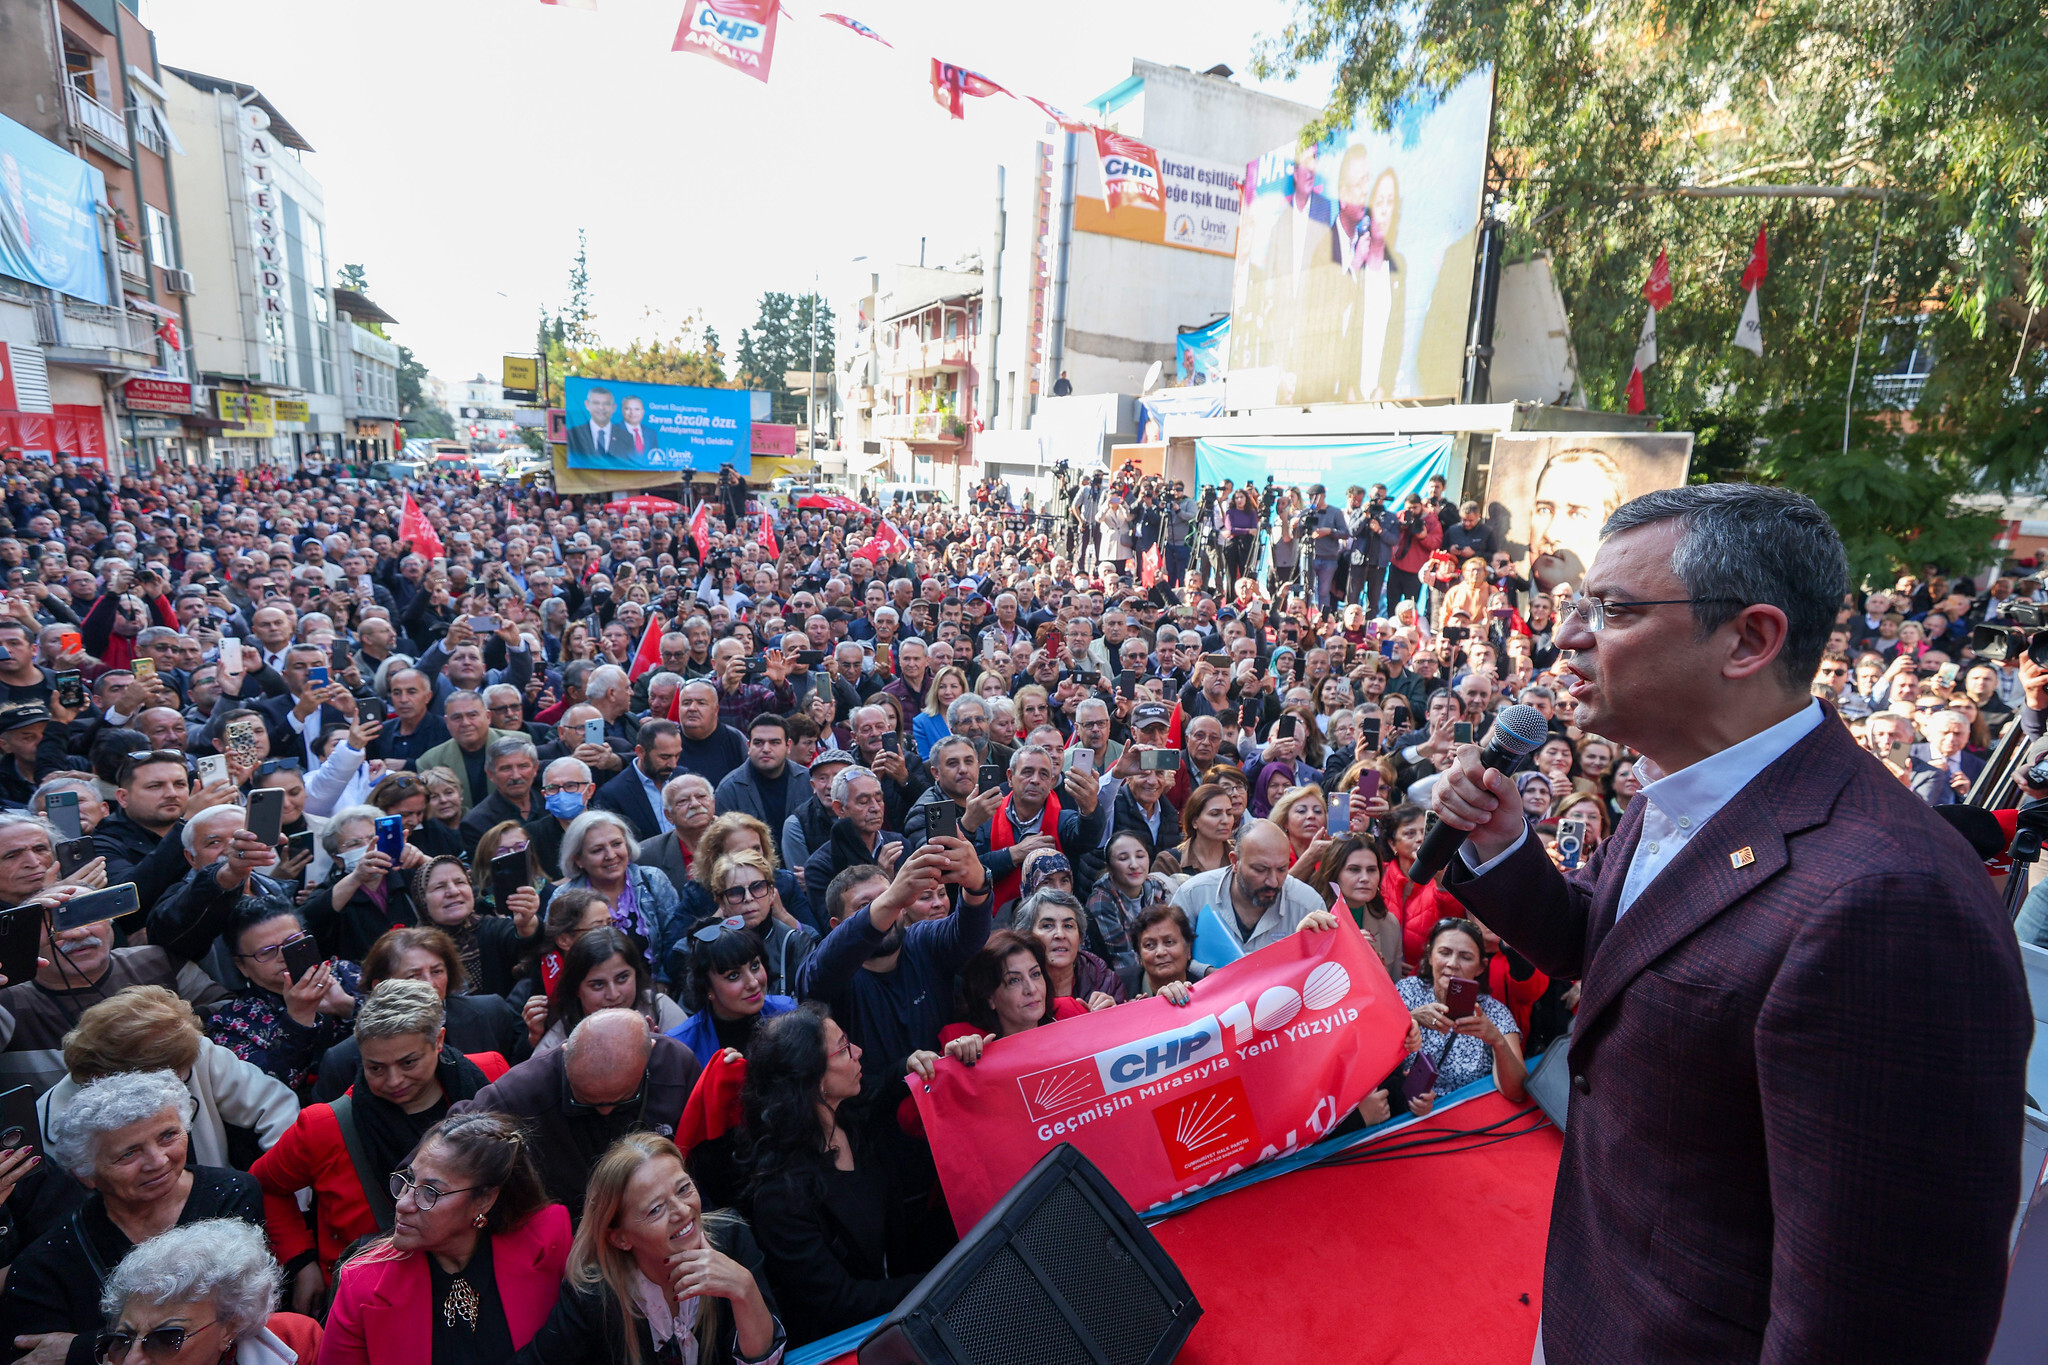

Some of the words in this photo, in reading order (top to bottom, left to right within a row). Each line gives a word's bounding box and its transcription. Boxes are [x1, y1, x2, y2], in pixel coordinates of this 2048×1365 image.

[699, 8, 760, 42] CHP
[685, 31, 760, 68] ANTALYA
[1105, 159, 1153, 178] CHP
[1162, 158, 1195, 180] fırsat
[1166, 184, 1188, 203] eğe
[1191, 190, 1213, 208] ışık
[1201, 216, 1227, 235] Ümit
[648, 402, 669, 411] Genel
[670, 403, 708, 415] Başkanımız
[674, 413, 710, 428] ÖZGÜR
[711, 417, 738, 429] ÖZEL
[690, 436, 705, 447] Hoş
[706, 436, 734, 446] Geldiniz
[668, 447, 691, 460] Ümit
[1110, 1031, 1211, 1084] CHP
[1218, 961, 1351, 1046] 100
[1037, 1095, 1133, 1142] Geçmişin
[1139, 1058, 1230, 1101] Mirasıyla
[1236, 1039, 1279, 1061] Yeni
[1284, 1005, 1359, 1042] Yüzyıla
[1184, 1152, 1216, 1169] CUMHURİYET
[1216, 1146, 1231, 1155] HALK
[1230, 1138, 1250, 1149] PARTİSİ
